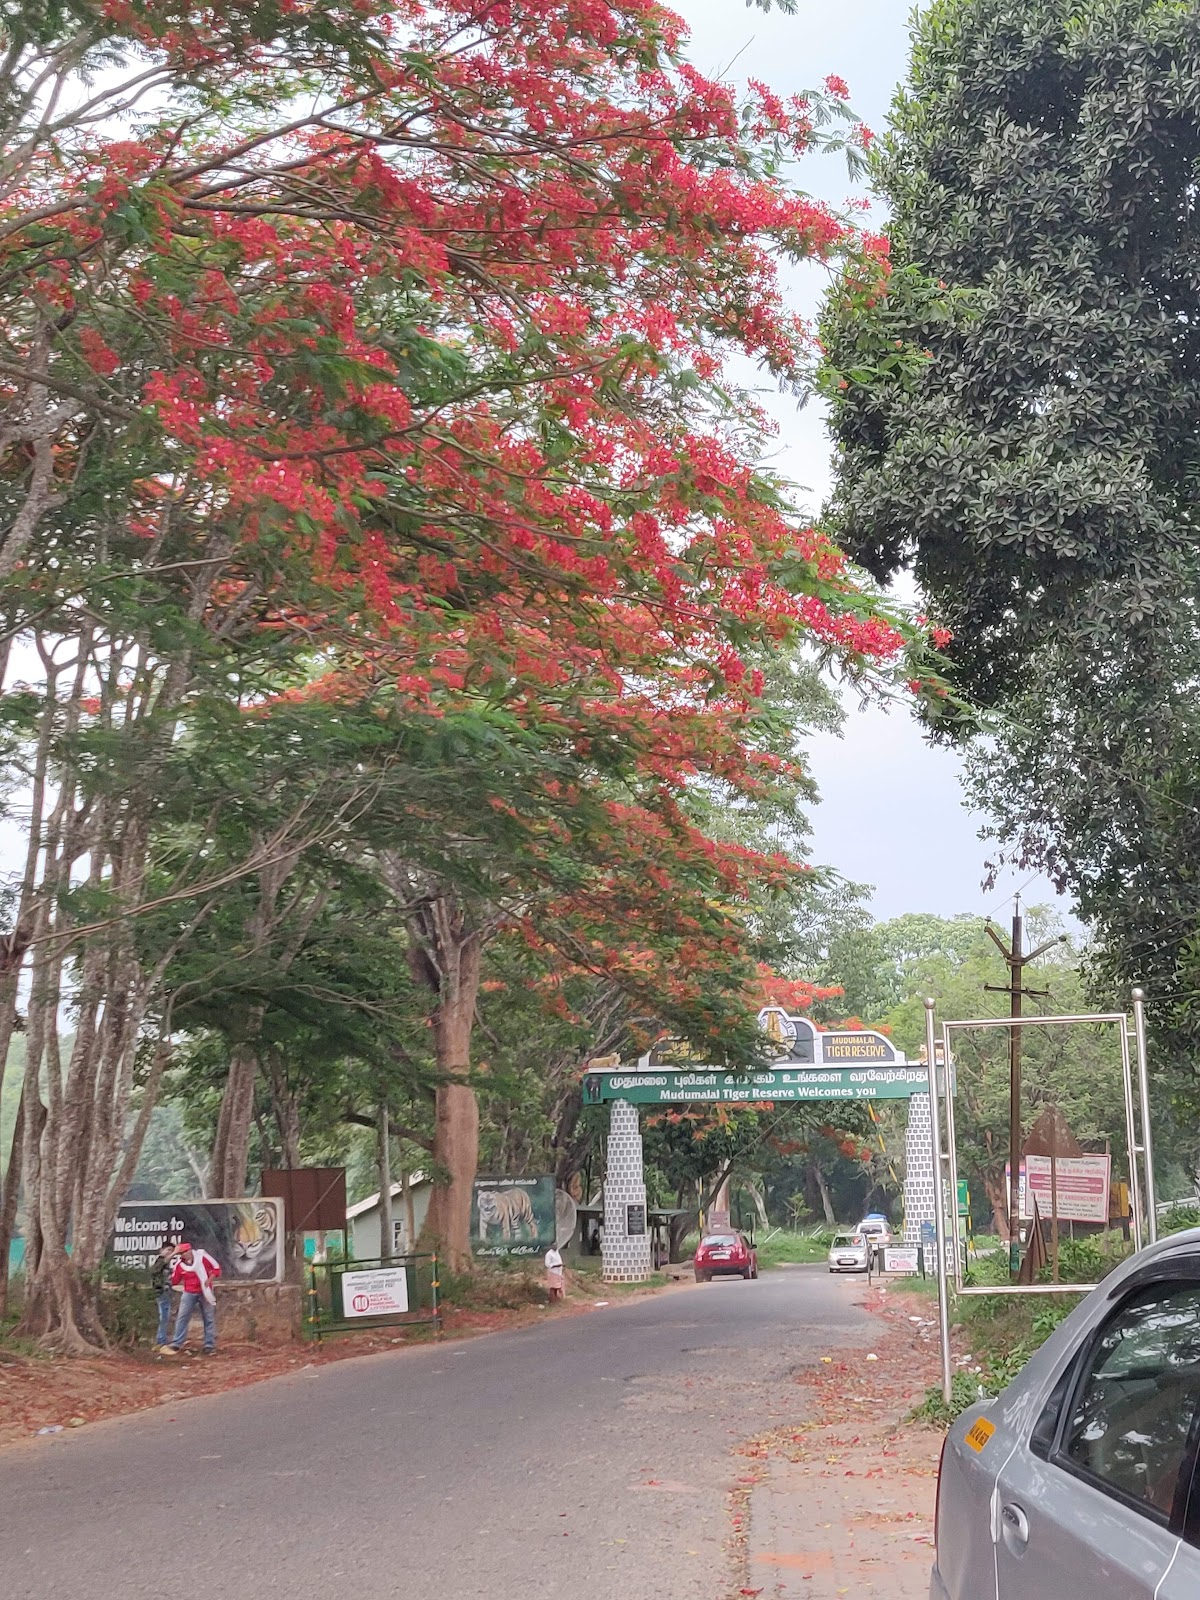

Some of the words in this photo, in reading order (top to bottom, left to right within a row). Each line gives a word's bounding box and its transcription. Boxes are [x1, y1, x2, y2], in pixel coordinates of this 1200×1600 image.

[831, 1036, 876, 1045] MUDUMALAI
[826, 1045, 851, 1058] TIGER
[852, 1044, 886, 1057] RESERVE
[609, 1076, 668, 1089] முதுமலை
[674, 1073, 716, 1088] புலிகள்
[782, 1070, 842, 1083] உங்களை
[660, 1089, 720, 1100] Mudumalai
[723, 1088, 750, 1101] Tiger
[752, 1087, 795, 1099] Reserve
[798, 1086, 853, 1098] Welcomes
[856, 1087, 876, 1098] you
[114, 1217, 168, 1233] Welcome
[170, 1216, 185, 1231] to
